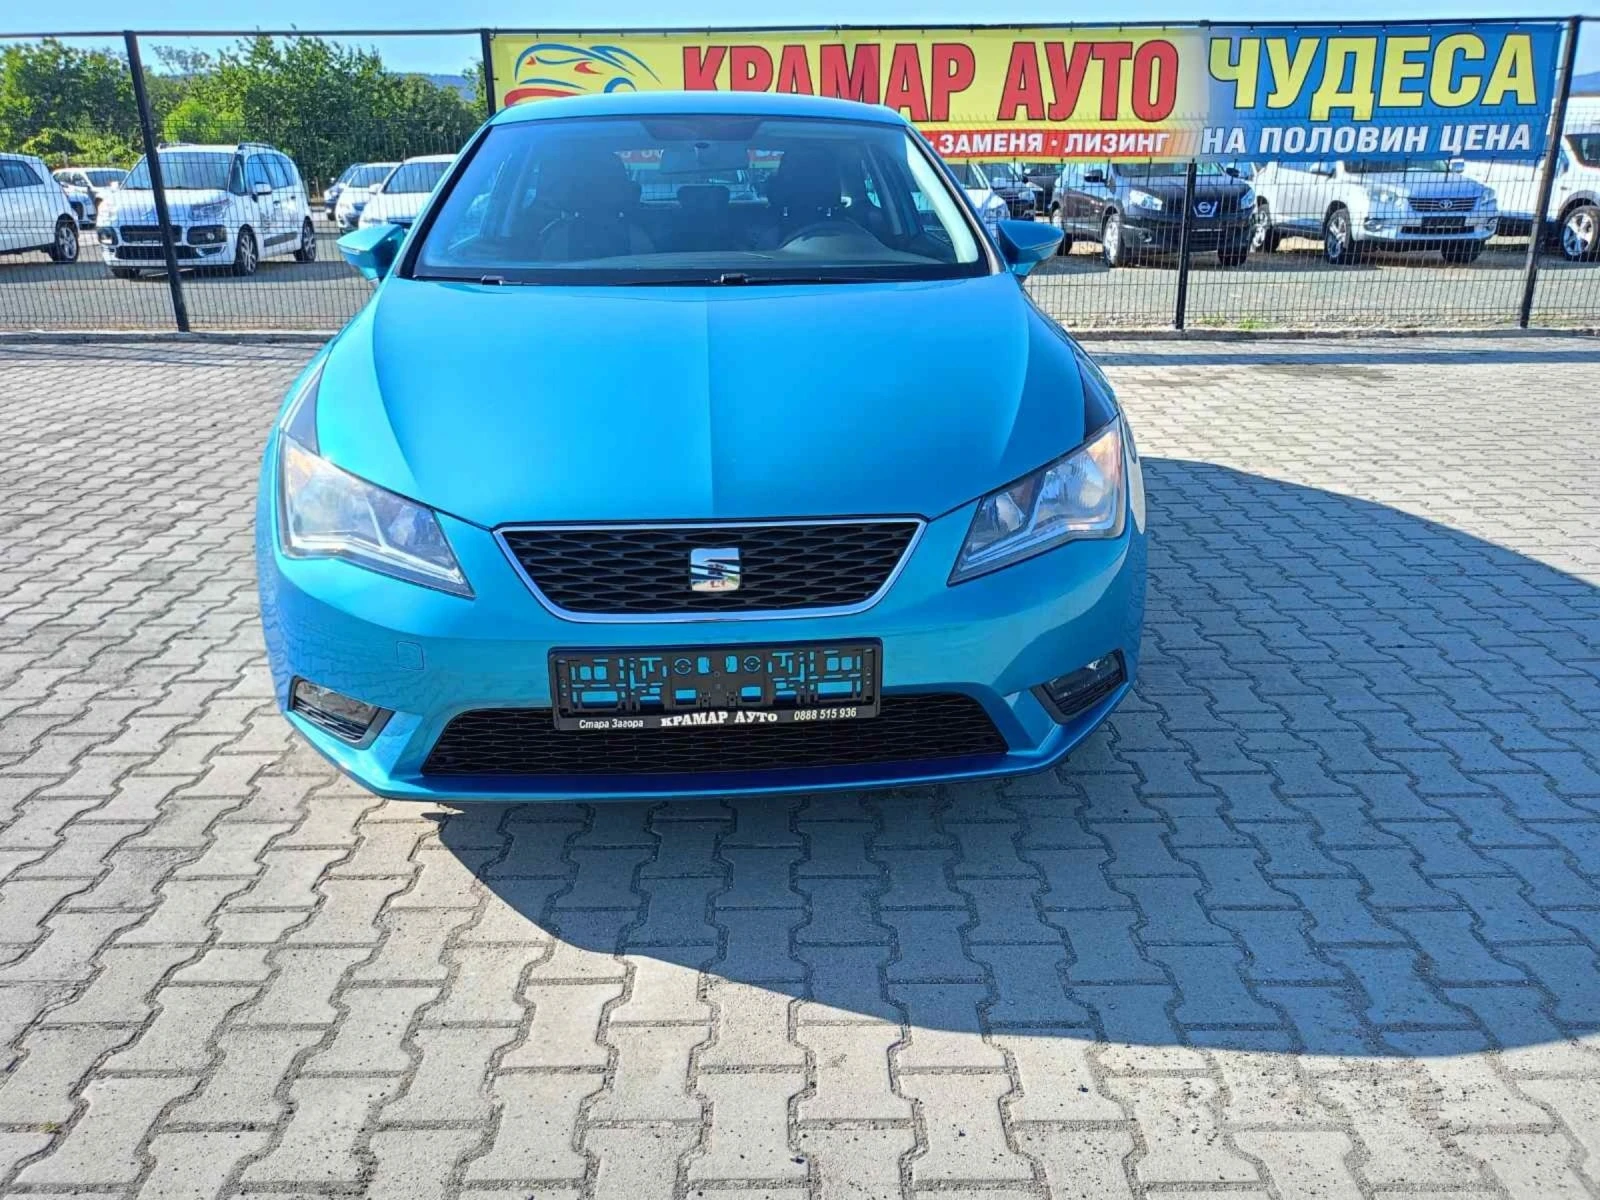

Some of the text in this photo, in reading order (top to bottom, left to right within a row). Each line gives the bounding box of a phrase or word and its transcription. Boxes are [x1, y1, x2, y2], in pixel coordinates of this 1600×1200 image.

[682, 39, 1179, 122] КРАМАР АУТО
[1208, 33, 1537, 122] ЧУДЕСА
[938, 132, 1169, 155] ЗАМЕНЯ ЛИЗИНГ
[1202, 123, 1532, 155] НА ПОЛОВИН ЦЕНА
[579, 718, 643, 729] Стара Загора
[660, 711, 728, 727] КРАМАР
[793, 707, 857, 721] 0888 515 936
